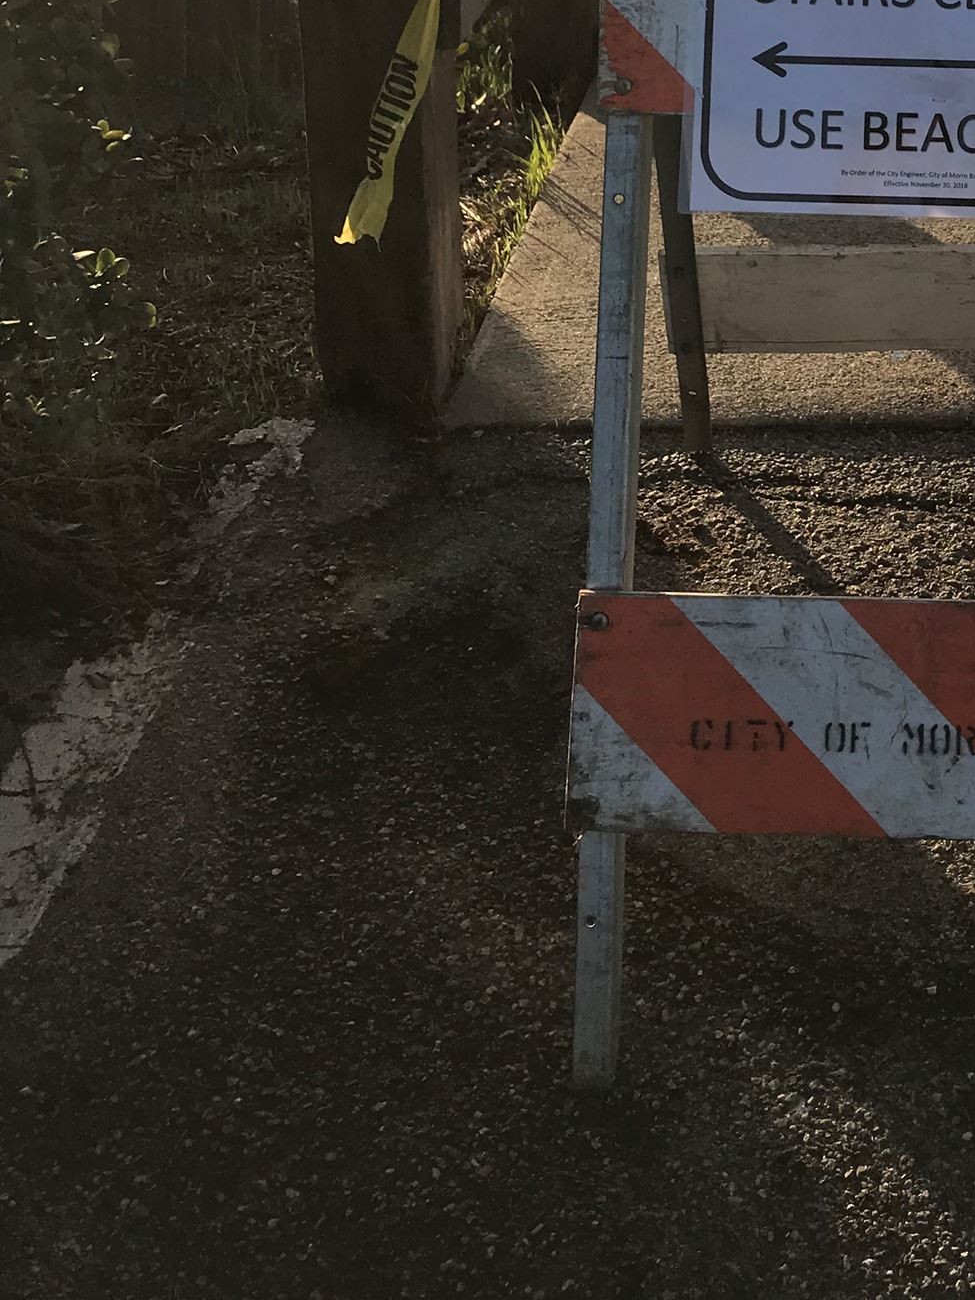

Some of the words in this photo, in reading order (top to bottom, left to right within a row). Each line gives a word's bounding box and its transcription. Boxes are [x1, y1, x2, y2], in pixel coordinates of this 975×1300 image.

[367, 52, 419, 181] CAUTION
[754, 107, 845, 151] USE
[841, 169, 849, 177] By
[887, 170, 899, 179] City
[900, 171, 928, 179] Engineer,
[928, 172, 941, 180] City
[883, 180, 909, 188] Effective
[910, 181, 942, 189] November
[689, 718, 794, 753] CITY
[823, 721, 872, 754] OF
